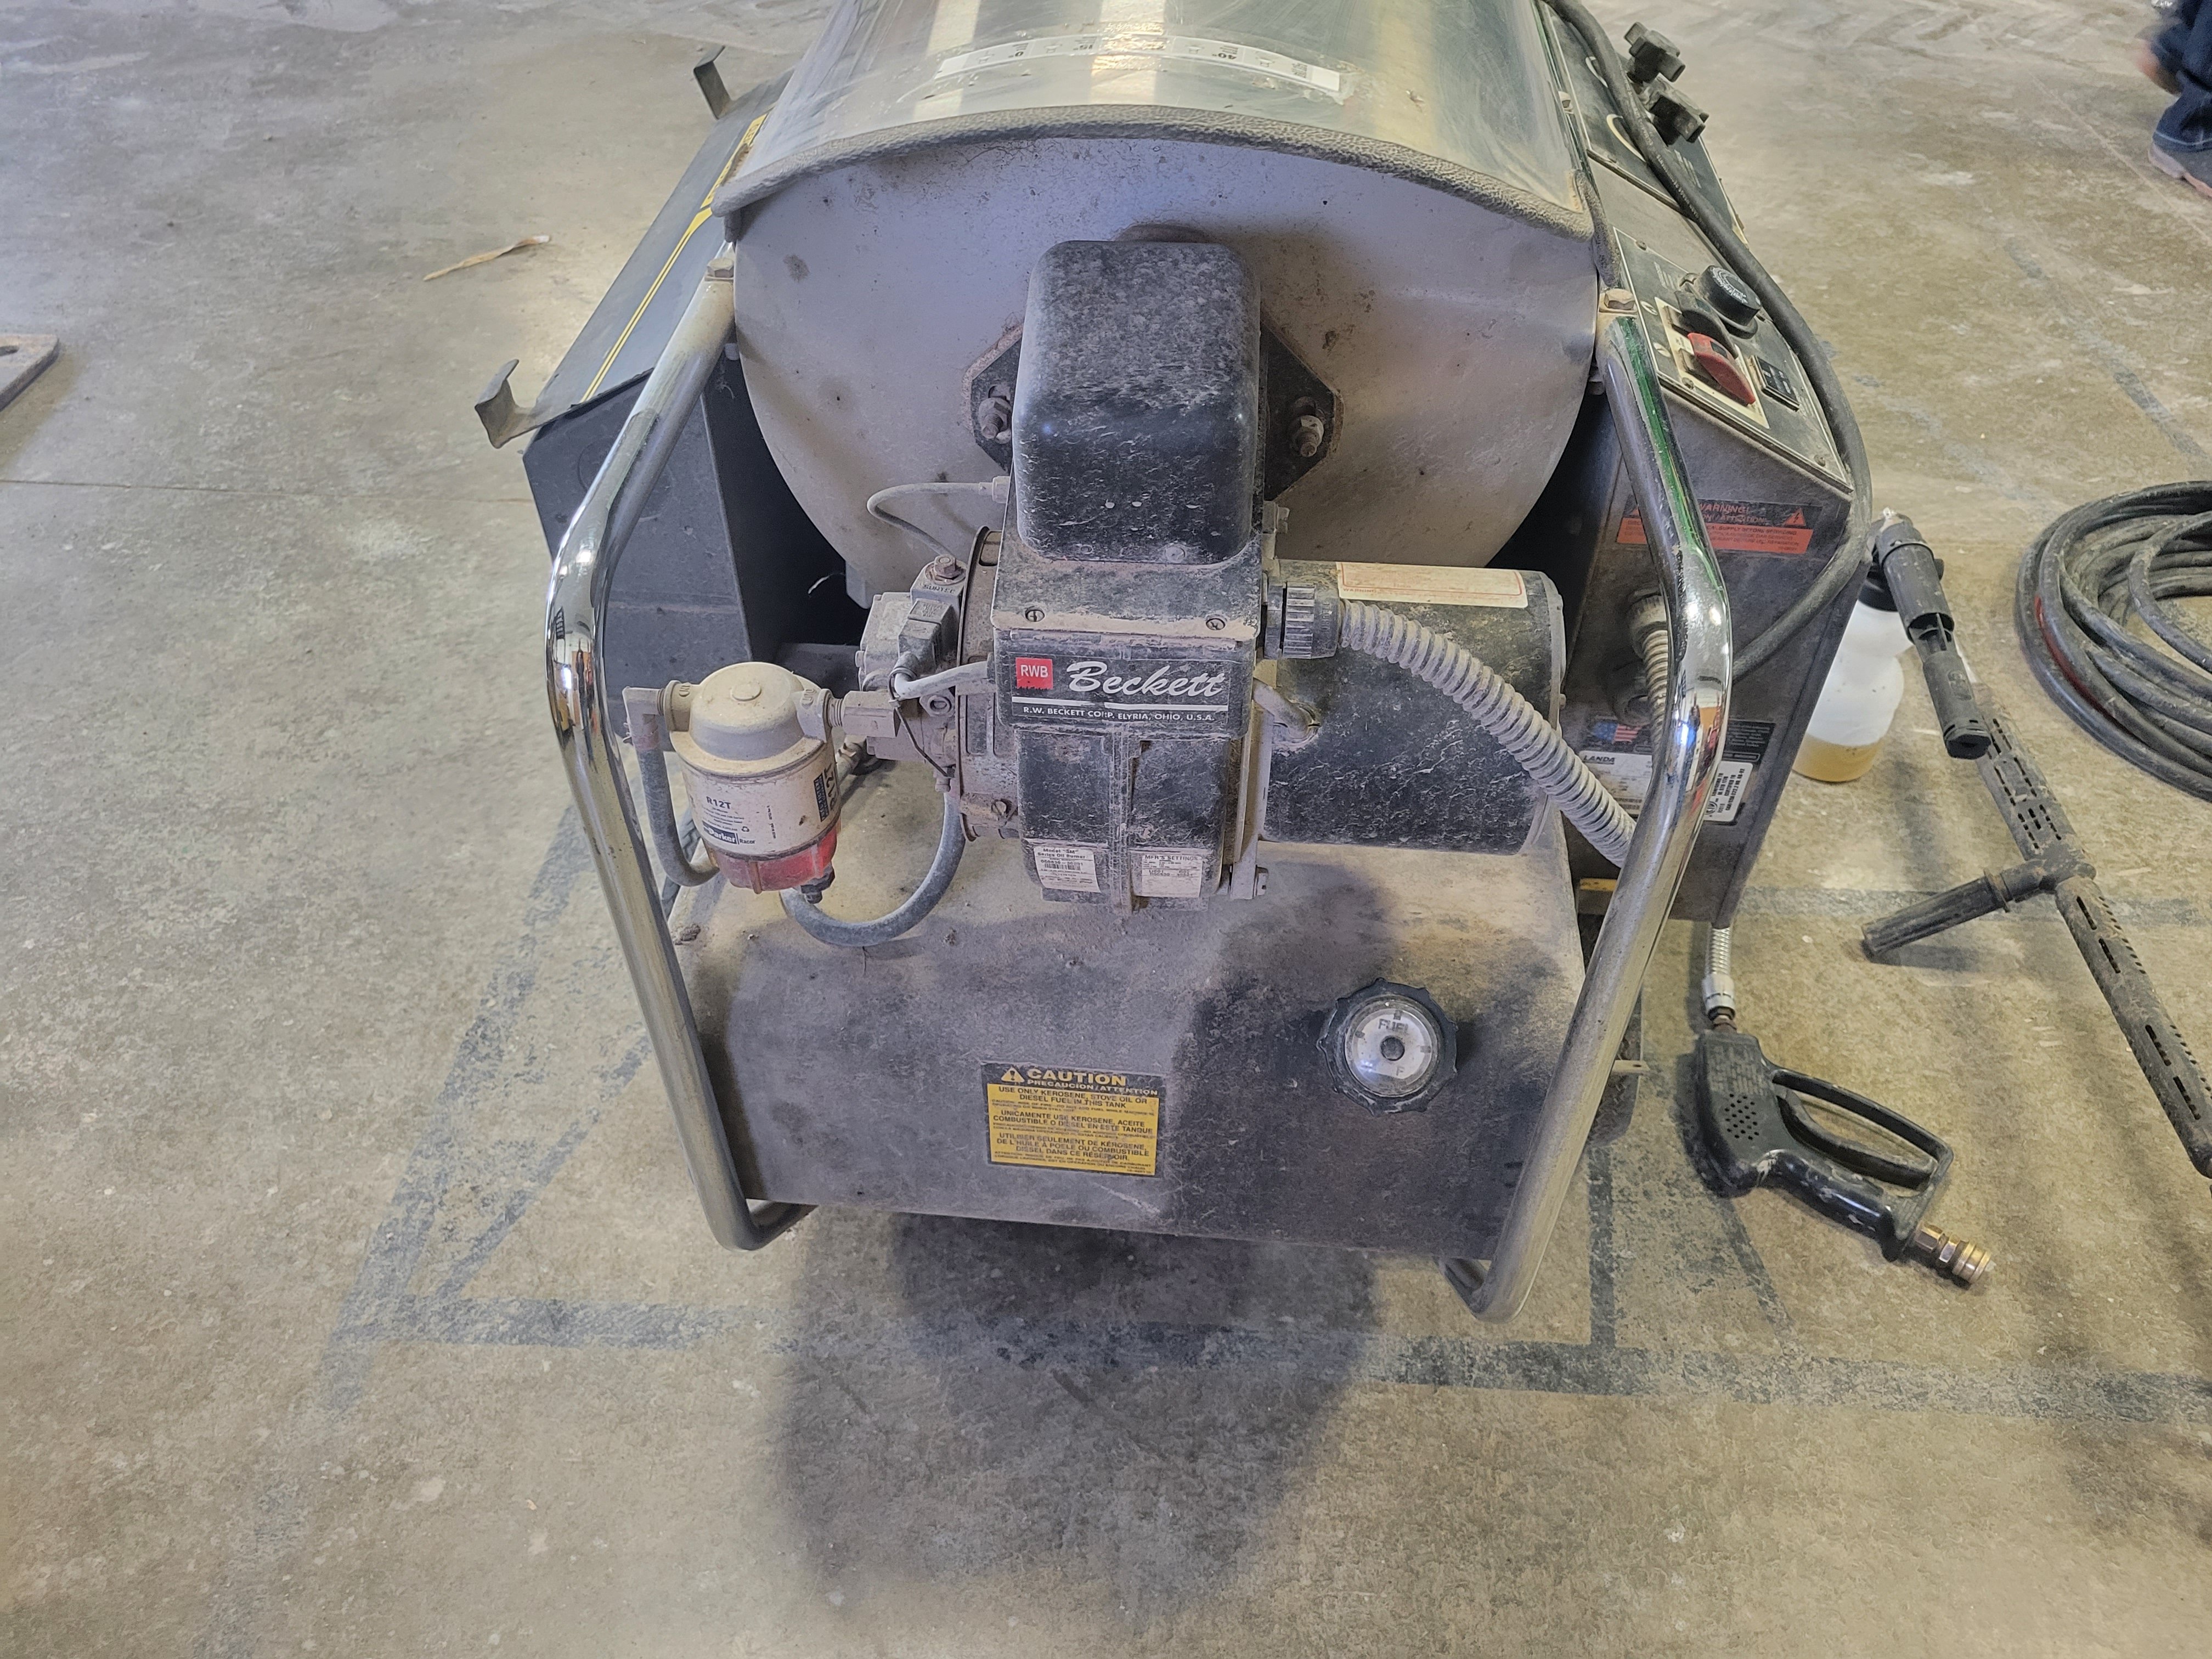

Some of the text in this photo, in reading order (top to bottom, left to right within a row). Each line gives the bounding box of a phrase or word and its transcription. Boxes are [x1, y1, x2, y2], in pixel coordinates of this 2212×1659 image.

[1020, 665, 1048, 678] RWB
[1066, 661, 1225, 697] Beckett
[1047, 708, 1085, 716] BECKETT
[706, 796, 731, 809] R12T
[708, 827, 736, 843] Parker
[1378, 1019, 1408, 1032] FUEL
[1027, 1068, 1126, 1086] CAUTION
[1041, 1090, 1088, 1099] KEROSENE,
[1001, 1110, 1051, 1119] UNICAMENTE
[1071, 1115, 1115, 1125] KEROSENE,
[993, 1115, 1047, 1125] COMBUSTIBLE
[1122, 1126, 1153, 1134] TANQUE
[1037, 1136, 1086, 1146] SEULEMENT
[1092, 1146, 1149, 1156] COMBUSTIBLE
